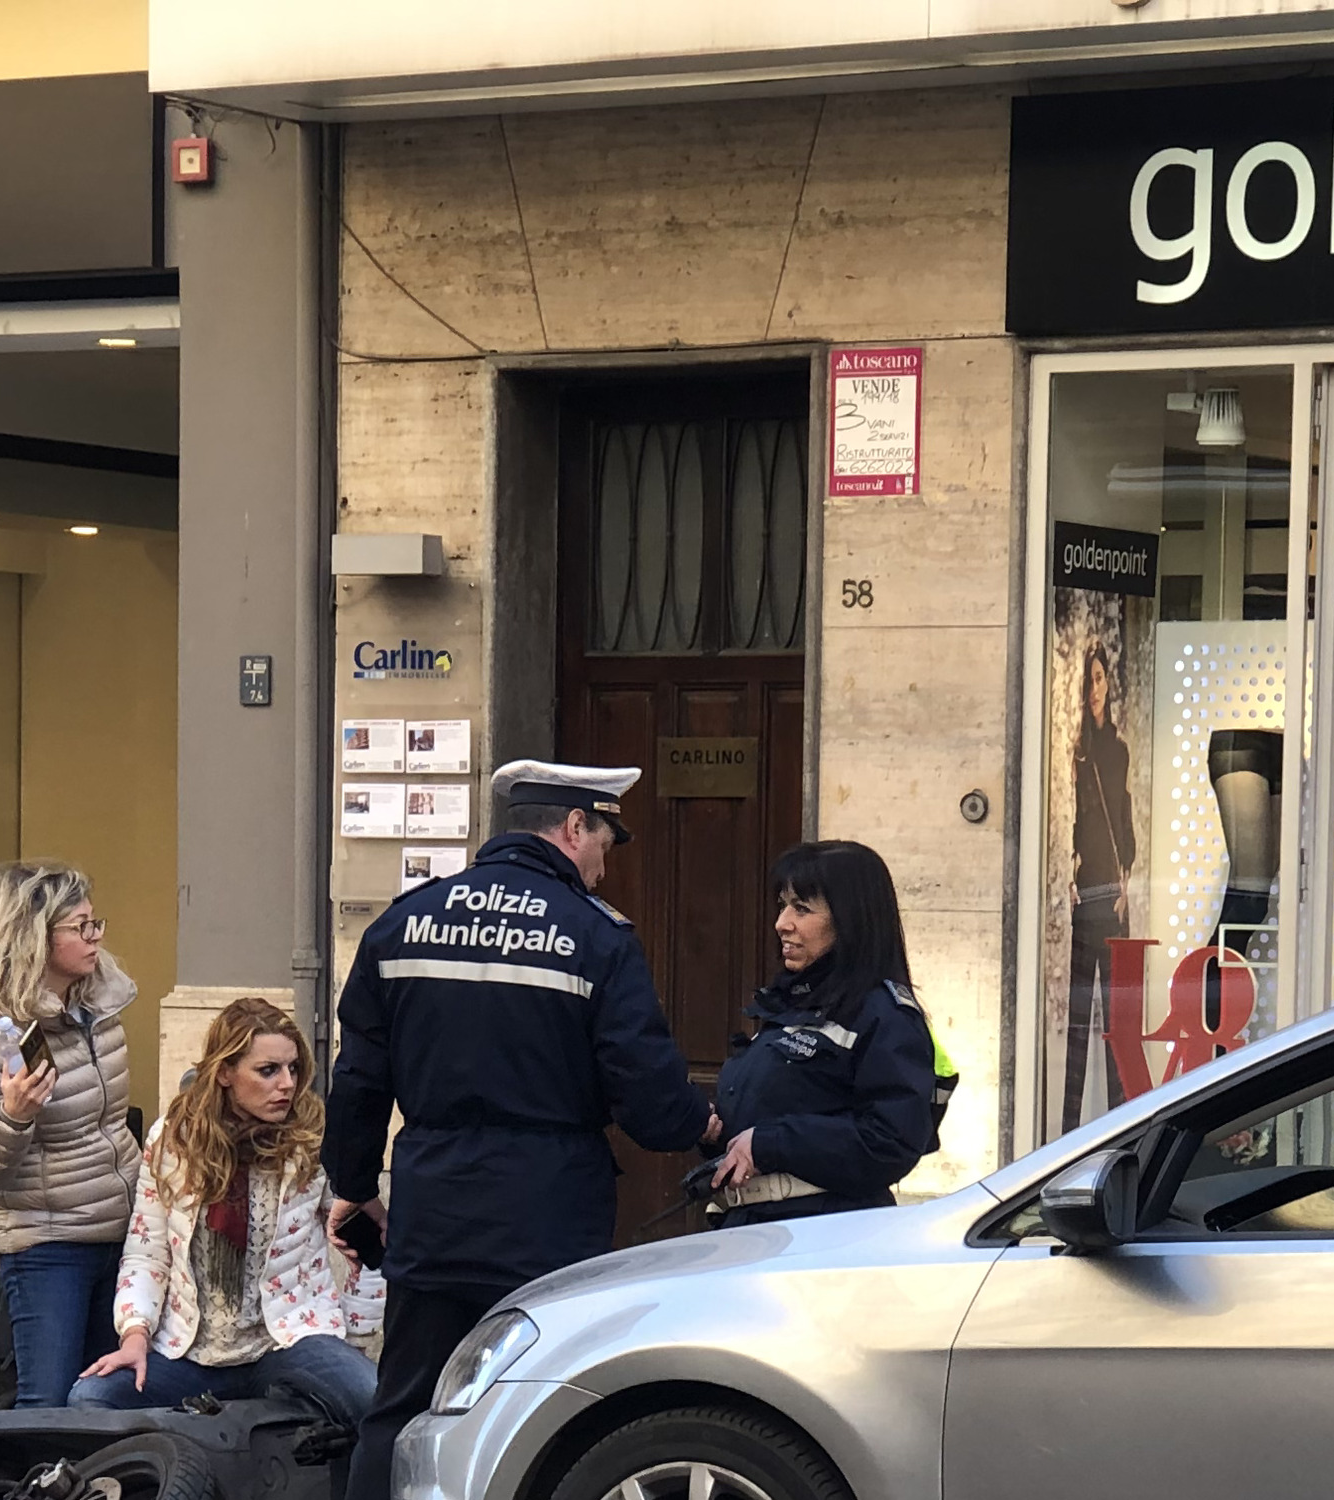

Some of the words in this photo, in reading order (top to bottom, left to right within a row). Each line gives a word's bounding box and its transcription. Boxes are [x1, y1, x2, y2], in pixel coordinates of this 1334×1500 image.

[853, 353, 918, 370] toscano
[852, 378, 901, 395] VENDE
[835, 402, 867, 431] 3
[867, 419, 895, 430] VANI
[867, 430, 880, 442] 2
[1063, 538, 1148, 580] goldenpoint
[842, 578, 874, 608] 58
[353, 639, 453, 672] Carlino
[670, 750, 745, 765] CARLINO
[444, 883, 548, 917] Polizia
[403, 914, 576, 956] Municipale
